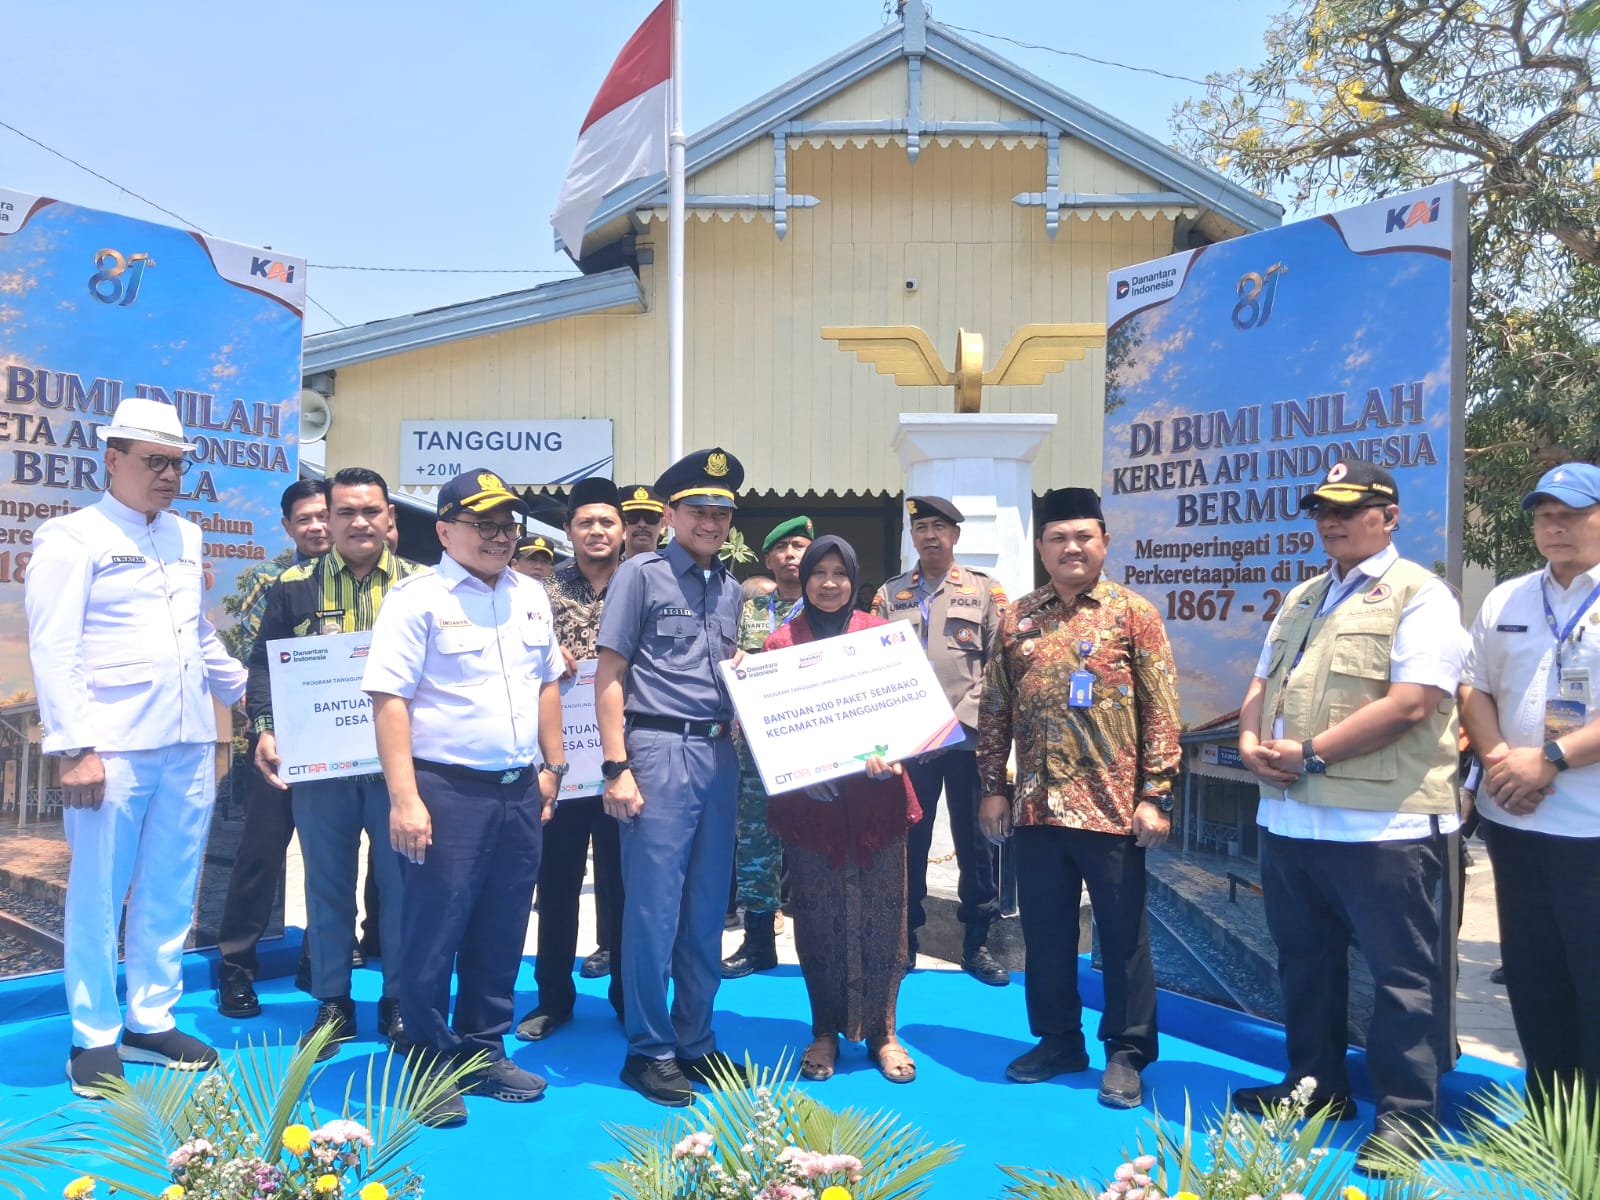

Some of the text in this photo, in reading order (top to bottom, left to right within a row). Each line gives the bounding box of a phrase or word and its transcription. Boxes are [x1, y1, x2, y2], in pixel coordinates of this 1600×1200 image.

[1132, 268, 1177, 286] Danantara
[1132, 279, 1174, 297] Indonesia
[1130, 381, 1426, 459] DI BUMI INILAH
[413, 431, 562, 452] TANGGUNG
[1112, 458, 1209, 496] KERETA
[1214, 452, 1260, 485] API
[1135, 532, 1315, 562] Memperingati 159
[1124, 563, 1266, 588] Perkeretaapian
[1271, 559, 1291, 582] di
[951, 598, 981, 607] POLRI
[1167, 589, 1236, 621] 1867
[764, 678, 918, 725] BANTUAN 200 PAKET SEMBAKO
[766, 690, 927, 738] KECAMATAN TANGGUNGHARJO
[336, 714, 368, 726] DESA
